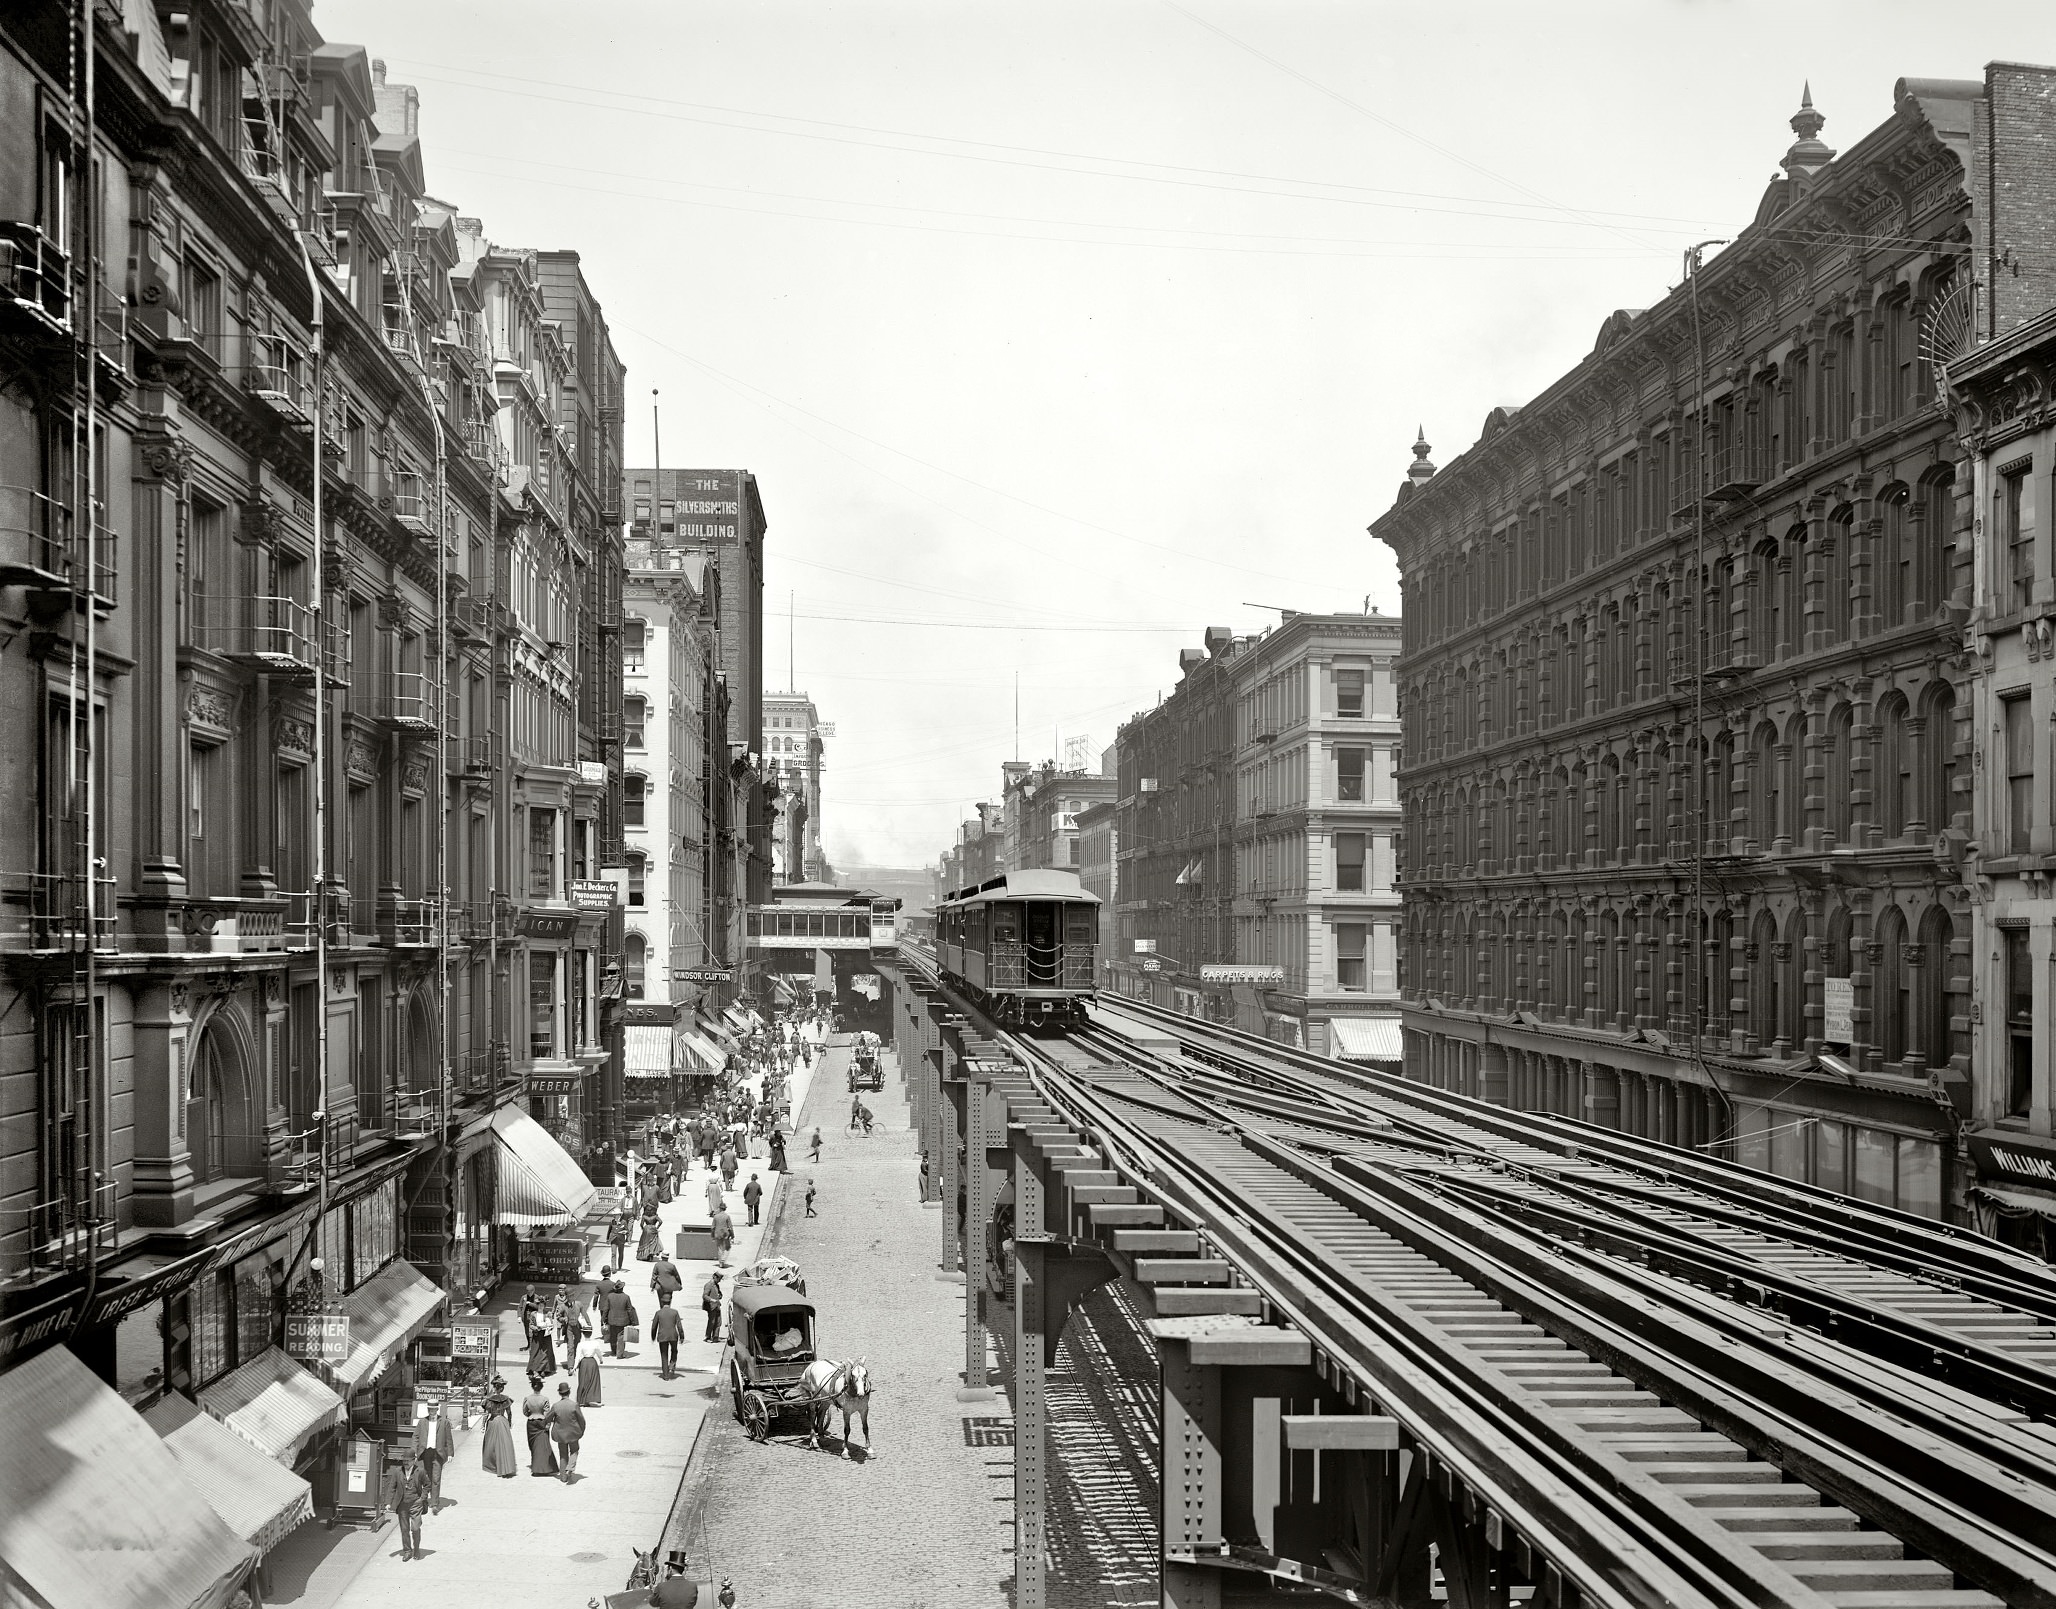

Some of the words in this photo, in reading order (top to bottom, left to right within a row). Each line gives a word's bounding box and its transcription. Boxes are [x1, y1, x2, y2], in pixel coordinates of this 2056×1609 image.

[696, 479, 719, 491] THE
[676, 500, 738, 515] SILVERSMITHS
[679, 523, 737, 538] BUILDING.
[572, 891, 613, 901] PHOTOGRAPHIC
[578, 899, 610, 907] SUPPLIES.
[674, 971, 702, 980] WINDSOR
[704, 972, 731, 981] CLIFTON
[1202, 970, 1245, 978] CARPETS
[1258, 971, 1284, 979] RUGS
[531, 1081, 570, 1092] WEBER
[557, 1118, 579, 1130] WEBER
[538, 1256, 579, 1264] FLORIST
[96, 1287, 147, 1323] IRISH
[147, 1262, 200, 1299] STORE
[289, 1342, 345, 1352] READING.
